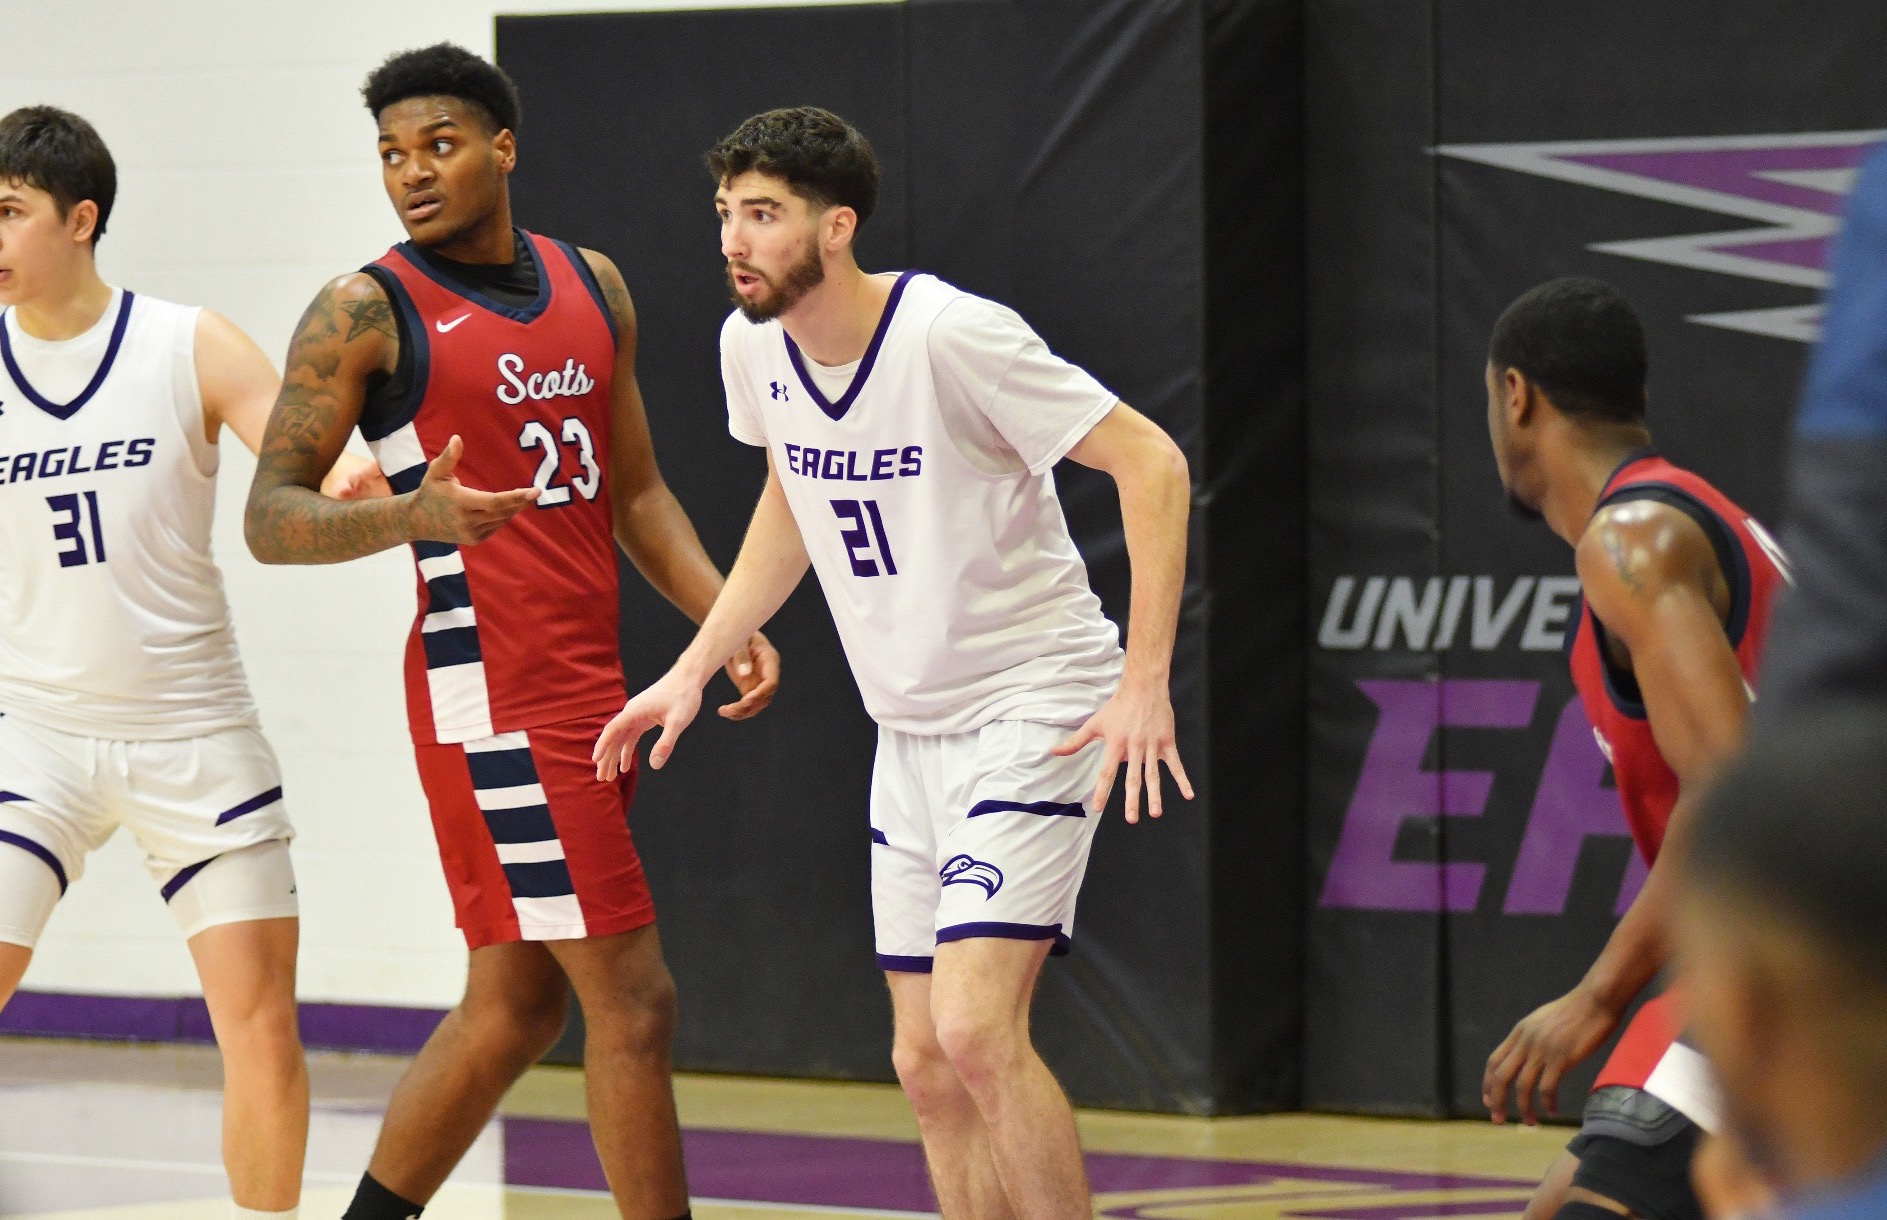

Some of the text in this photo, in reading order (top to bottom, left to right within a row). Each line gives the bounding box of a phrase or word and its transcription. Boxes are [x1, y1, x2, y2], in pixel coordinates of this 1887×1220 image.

[496, 353, 595, 405] Scots
[0, 438, 155, 485] AGLES
[518, 416, 601, 509] 23
[784, 443, 923, 481] EAGLES
[45, 490, 106, 568] 31
[829, 499, 898, 577] 21
